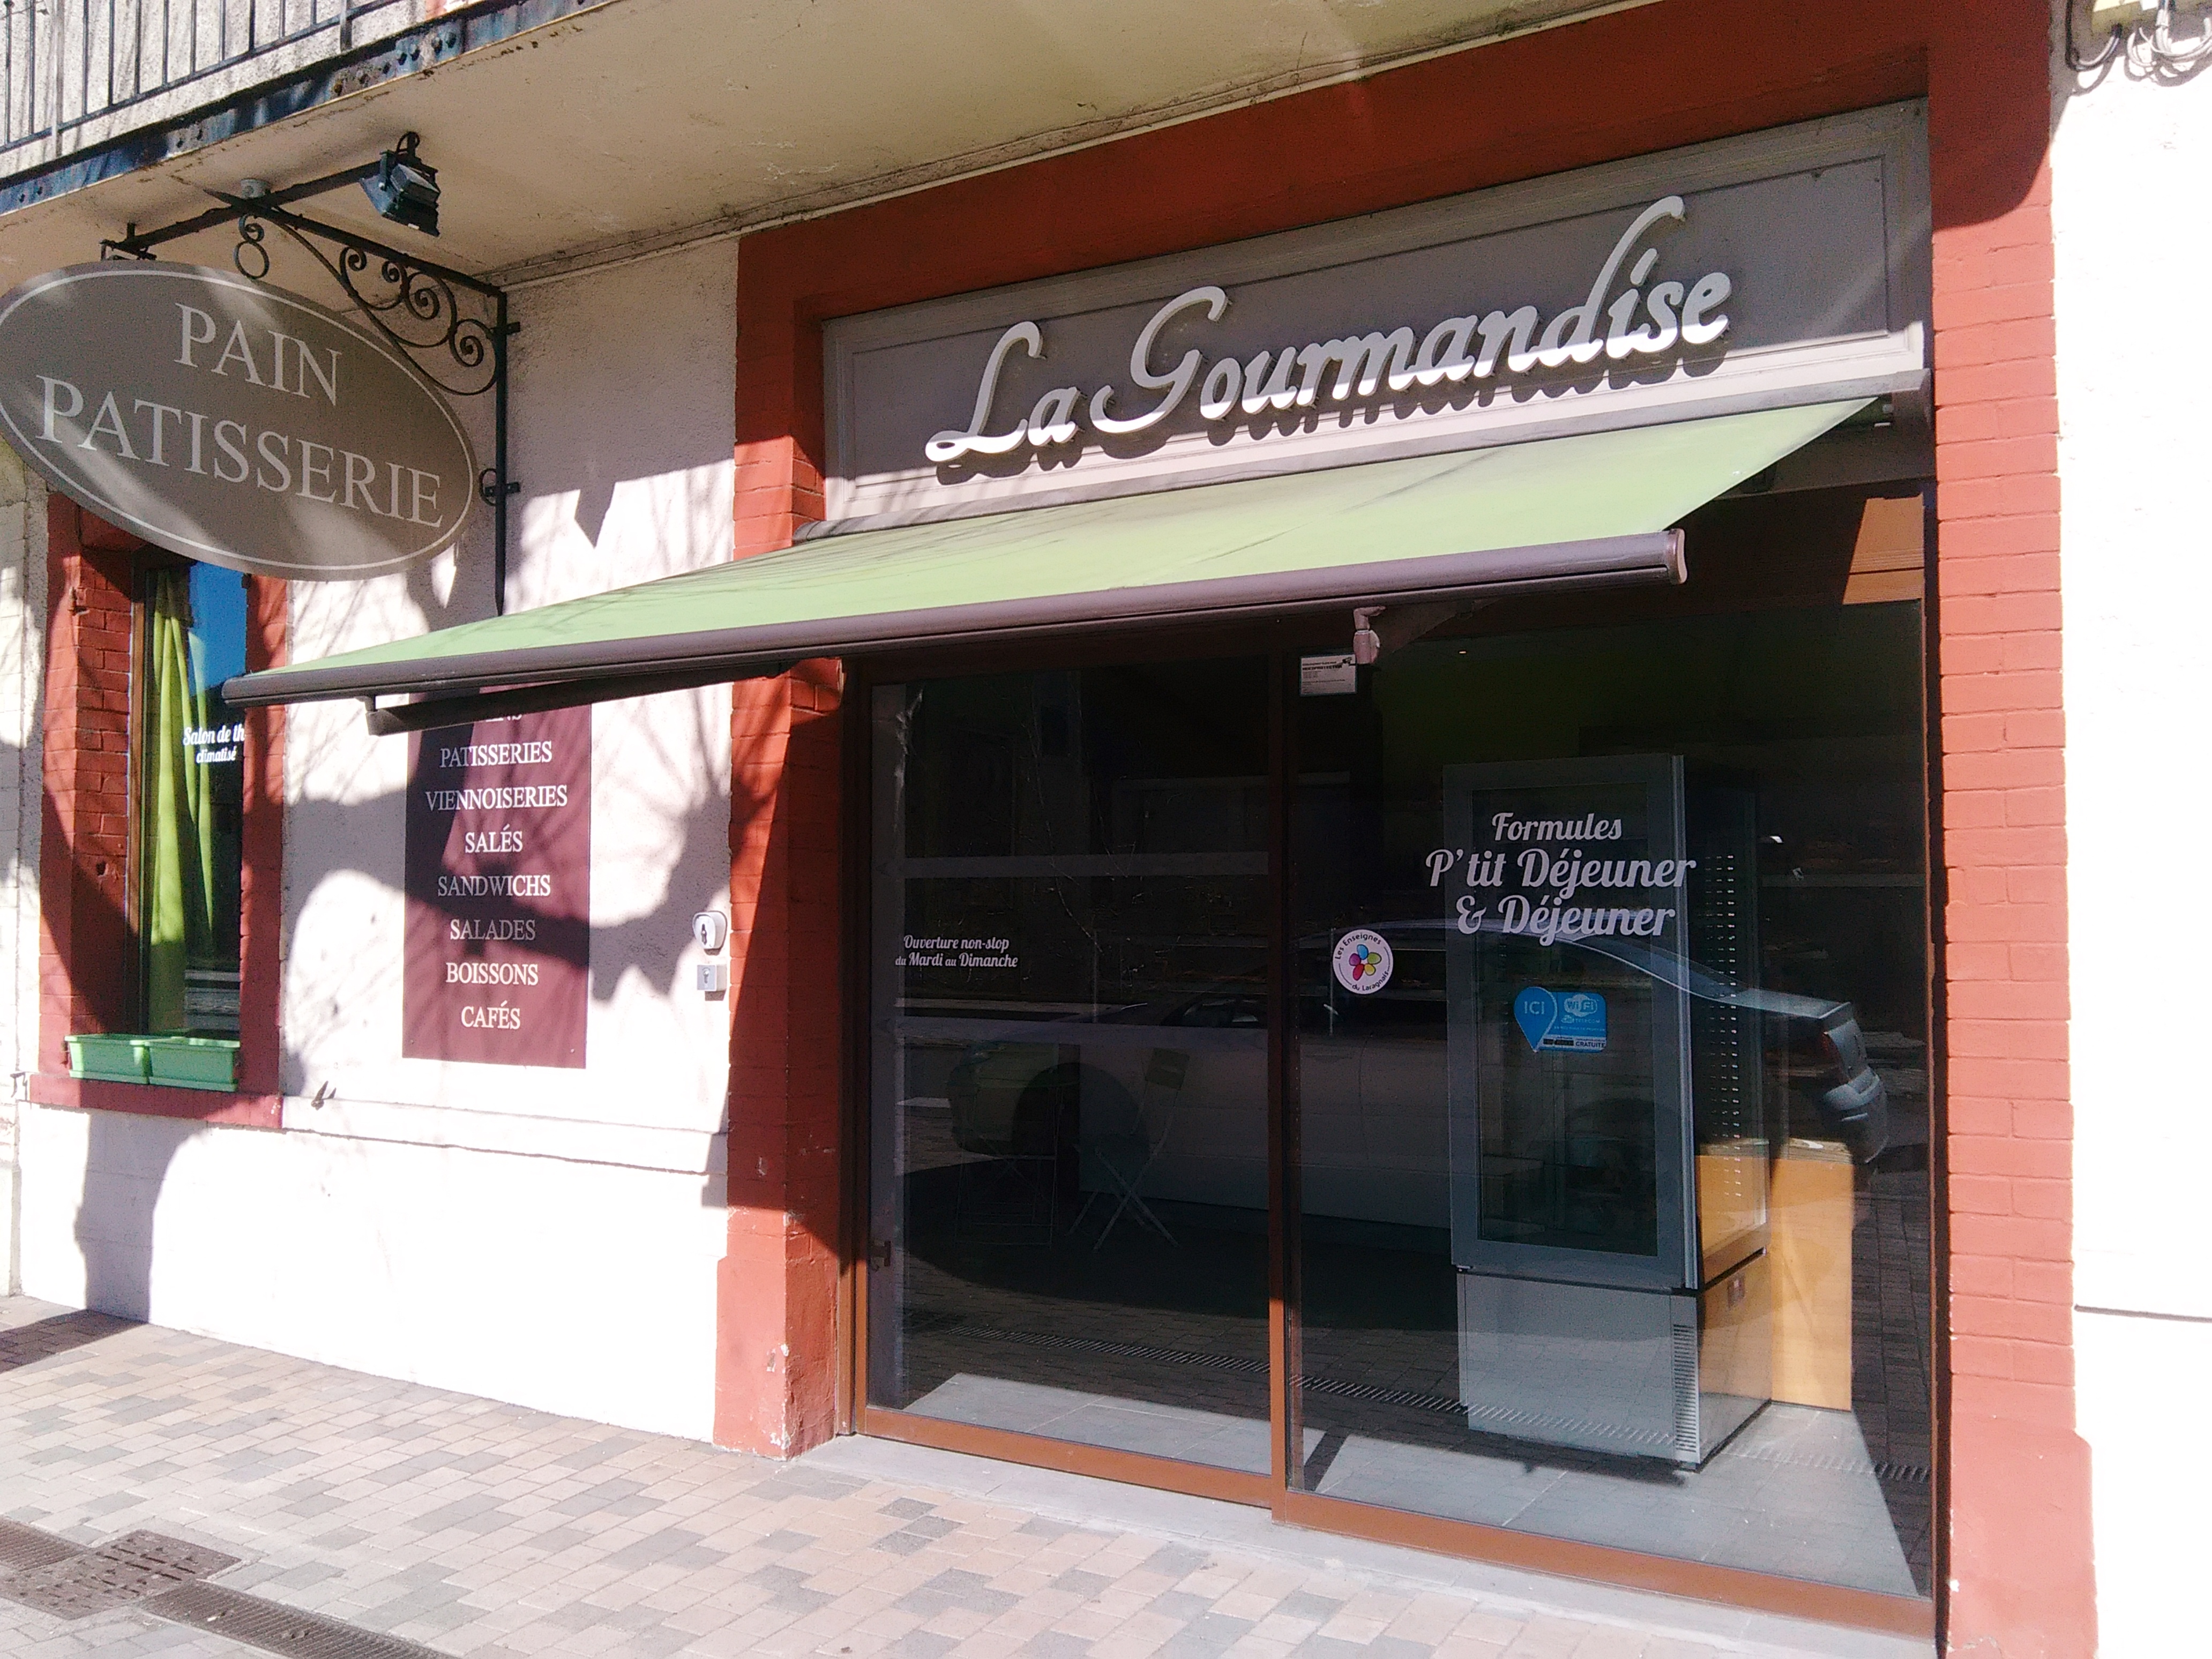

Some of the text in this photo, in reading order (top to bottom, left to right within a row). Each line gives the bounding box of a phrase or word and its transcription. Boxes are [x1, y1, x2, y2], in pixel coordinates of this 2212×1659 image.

[924, 195, 1732, 462] La Gourmandise
[173, 302, 343, 407] PAIN
[35, 373, 444, 528] PATISSERIE
[183, 723, 245, 746] Salon de th
[196, 745, 237, 764] climatisé
[439, 740, 552, 768] PATISSERIES
[425, 784, 568, 811] VIENNOISERIES
[465, 823, 523, 854] SALÉS
[1491, 812, 1623, 841] Formules
[437, 874, 551, 897] SANDWICHS
[1517, 848, 1698, 900] Déjeuner
[450, 918, 536, 940] SALADES
[1455, 894, 1676, 947] & Déjeuner
[903, 934, 1010, 953] Ouverture non-stop
[1334, 933, 1382, 960] Les Enseignes
[895, 951, 1019, 967] du Mardi au Dimanche
[445, 962, 539, 986] BOISSONS
[1362, 970, 1389, 991] Laragnais
[461, 1000, 521, 1029] CAFÉS
[1524, 1001, 1545, 1014] ICI
